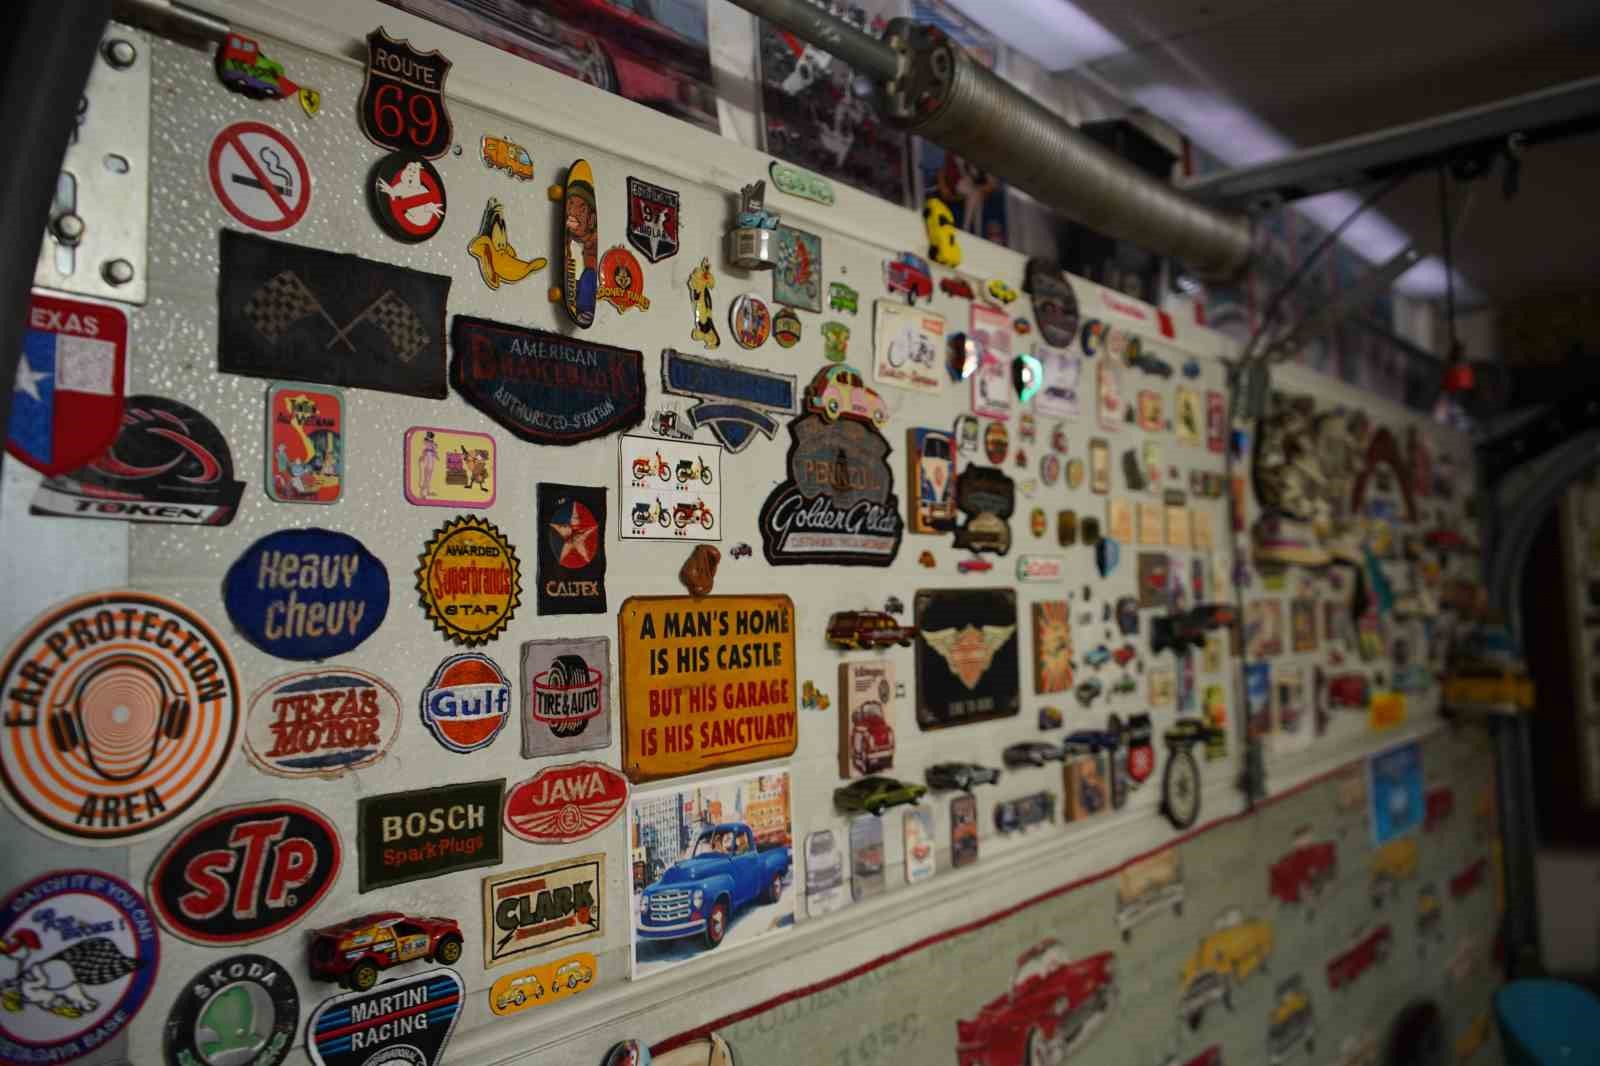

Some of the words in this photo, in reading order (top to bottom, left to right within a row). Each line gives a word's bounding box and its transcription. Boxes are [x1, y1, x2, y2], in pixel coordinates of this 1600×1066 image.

[375, 48, 436, 85] ROUTE
[374, 84, 438, 146] 69
[30, 306, 99, 336] EXAS
[510, 338, 599, 368] AMERICAN
[74, 500, 206, 520] TOKEN
[446, 545, 500, 557] AWARDED
[435, 558, 510, 600] Superbrands
[546, 580, 600, 598] CALTEX
[445, 604, 499, 616] STAR
[639, 613, 656, 640] A
[663, 611, 729, 639] MAN'S
[736, 609, 789, 636] HOME
[4, 660, 55, 727] EAR
[46, 608, 227, 704] PROTECTION
[650, 648, 669, 676] IS
[677, 646, 709, 674] HIS
[716, 642, 782, 670] CASTLE
[272, 687, 380, 723] TEXAS
[431, 688, 509, 717] Gulf
[649, 685, 683, 718] BUT
[688, 682, 717, 713] HIS
[723, 679, 789, 709] GARAGE
[265, 717, 381, 758] MOTOR
[640, 727, 658, 757] IS
[664, 721, 694, 752] HIS
[700, 710, 795, 749] SANCTUARY
[75, 785, 167, 828] AREA
[532, 771, 606, 806] JAWA
[382, 803, 486, 843] BOSCH
[179, 816, 318, 920] STP
[495, 879, 596, 931] CLARK
[351, 985, 428, 1023] MARTINI
[351, 1013, 429, 1052] RACING
